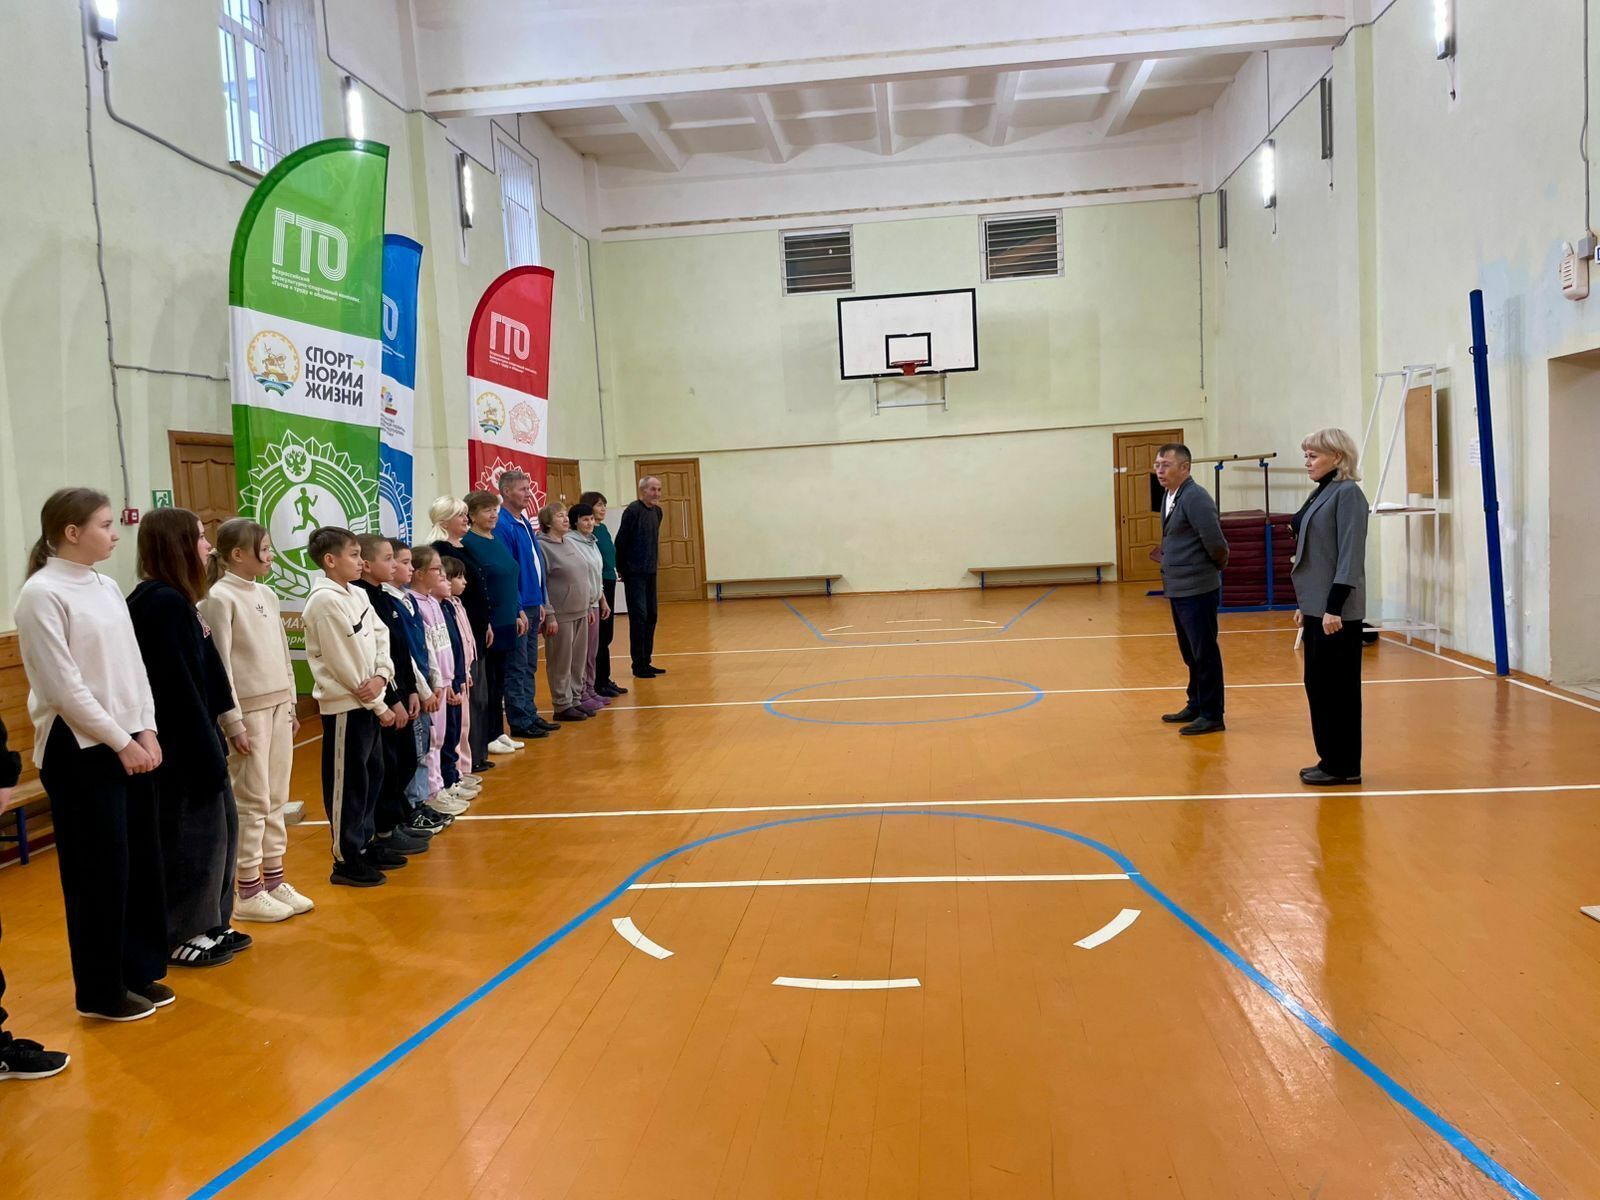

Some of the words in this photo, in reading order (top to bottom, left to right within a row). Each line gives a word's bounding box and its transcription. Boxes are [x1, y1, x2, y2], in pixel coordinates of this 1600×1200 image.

[272, 207, 348, 281] ГТО
[489, 311, 530, 361] ГТО
[305, 345, 354, 370] СПОРТ
[305, 363, 363, 390] НОРМА
[305, 381, 363, 407] ЖИЗНИ
